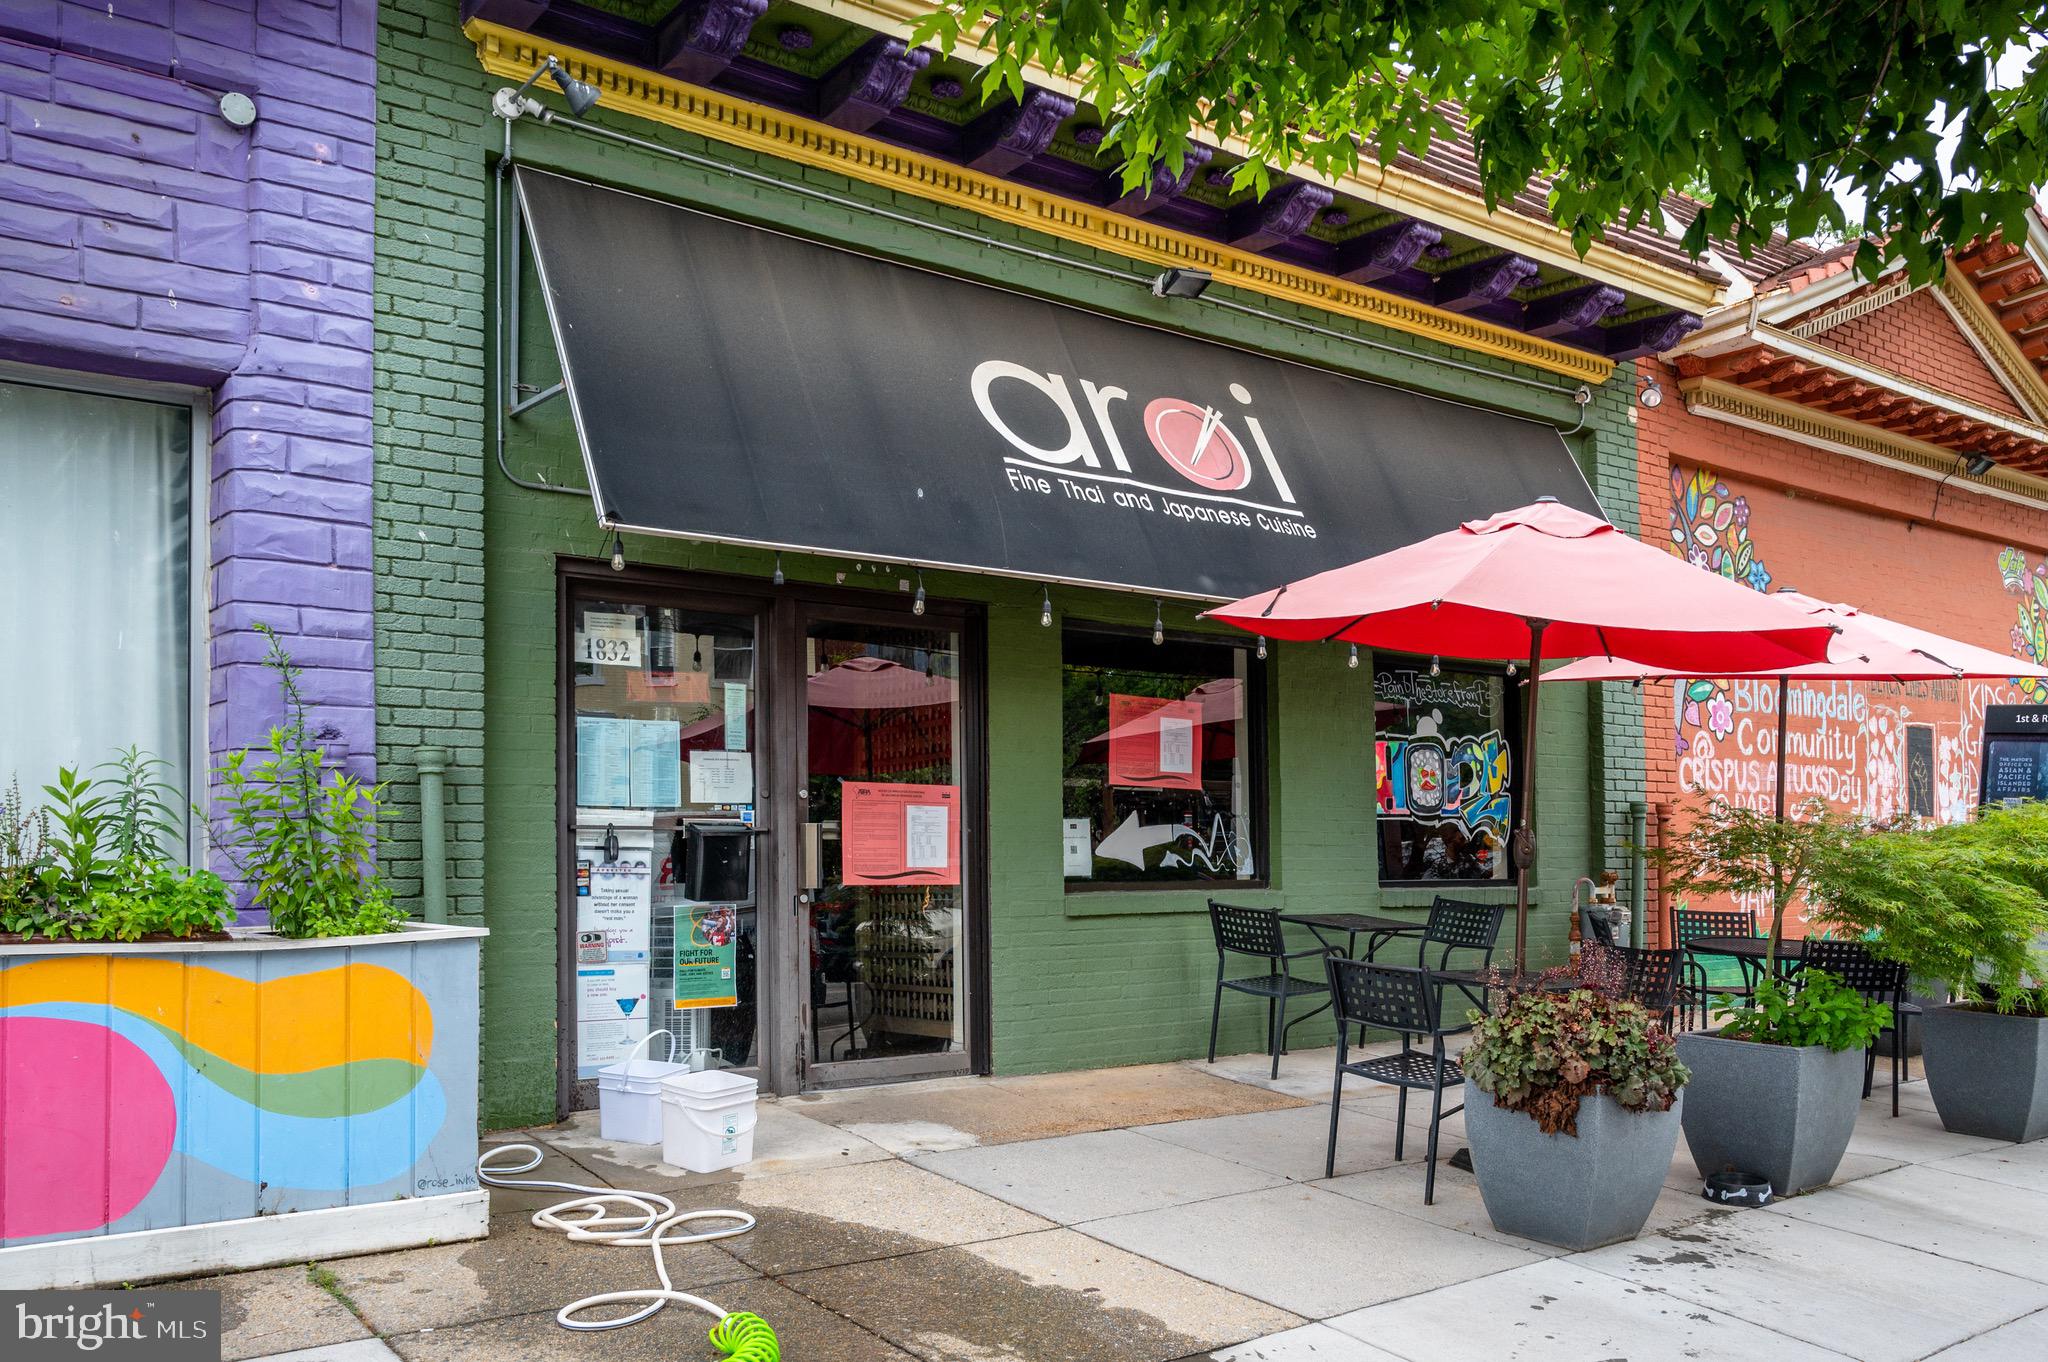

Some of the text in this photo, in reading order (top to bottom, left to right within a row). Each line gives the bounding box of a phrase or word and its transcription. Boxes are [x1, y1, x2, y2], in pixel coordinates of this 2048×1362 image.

[971, 360, 1296, 503] aroi
[1005, 467, 1317, 539] Fine Thai and Japanese Cuisine
[585, 638, 630, 661] 1832
[2015, 714, 2030, 723] 1st
[2031, 714, 2040, 723] &
[1679, 756, 1760, 794] CRISPUS
[1766, 760, 1831, 797] ATUCKS
[680, 948, 713, 957] FIGHT FOR
[694, 956, 720, 965] FUTURE
[417, 1173, 476, 1191] @rose_inks
